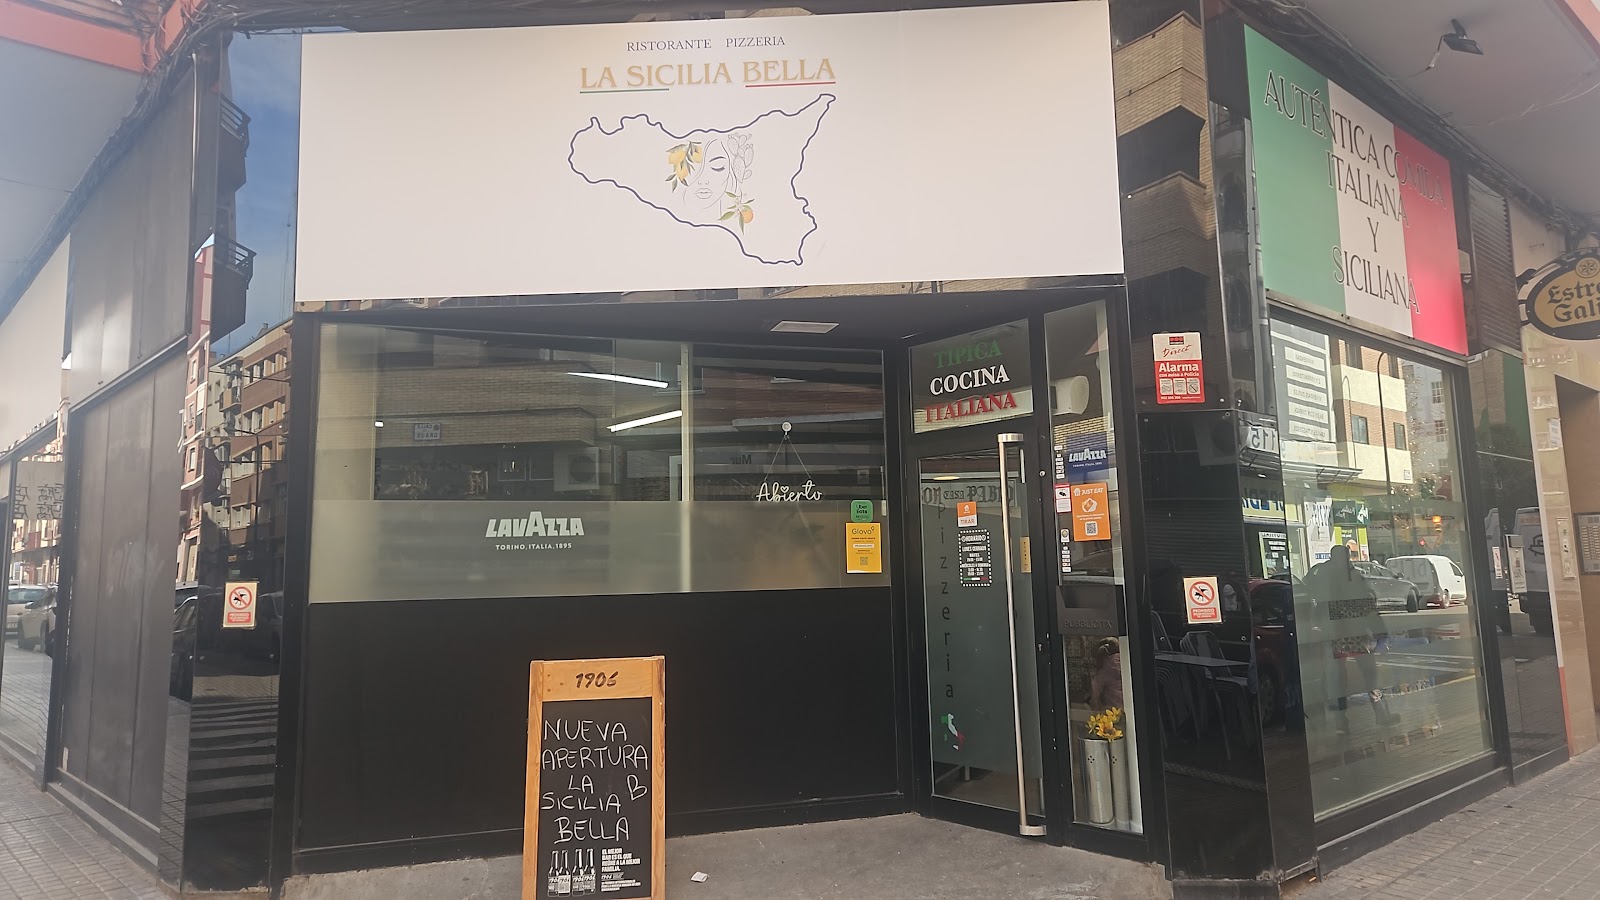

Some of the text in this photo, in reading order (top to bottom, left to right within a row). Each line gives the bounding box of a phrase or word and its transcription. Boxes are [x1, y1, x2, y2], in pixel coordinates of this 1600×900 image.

[626, 36, 786, 52] RISTORANTE PIZZERIA
[580, 58, 836, 89] LA SICILIA BELLA
[1263, 70, 1447, 210] AUTÉNTICA COMIDA
[1325, 150, 1411, 228] ITALIANA
[1366, 216, 1380, 253] Y
[1331, 245, 1421, 315] SICILIANA
[934, 339, 1003, 369] TIPICA
[1159, 362, 1199, 372] Alarma
[929, 364, 1011, 396] COCINA
[925, 391, 1018, 423] ITALIANA
[1068, 448, 1107, 462] LAVAZZA
[755, 479, 823, 502] Abierto
[966, 485, 1014, 503] PAB
[485, 511, 585, 538] LAVAZZA
[575, 671, 619, 689] 1906
[543, 718, 629, 742] NUEVA
[541, 744, 650, 770] APERTURA
[568, 774, 595, 795] LA
[540, 792, 623, 814] SICILIA
[553, 816, 630, 845] BELLA
